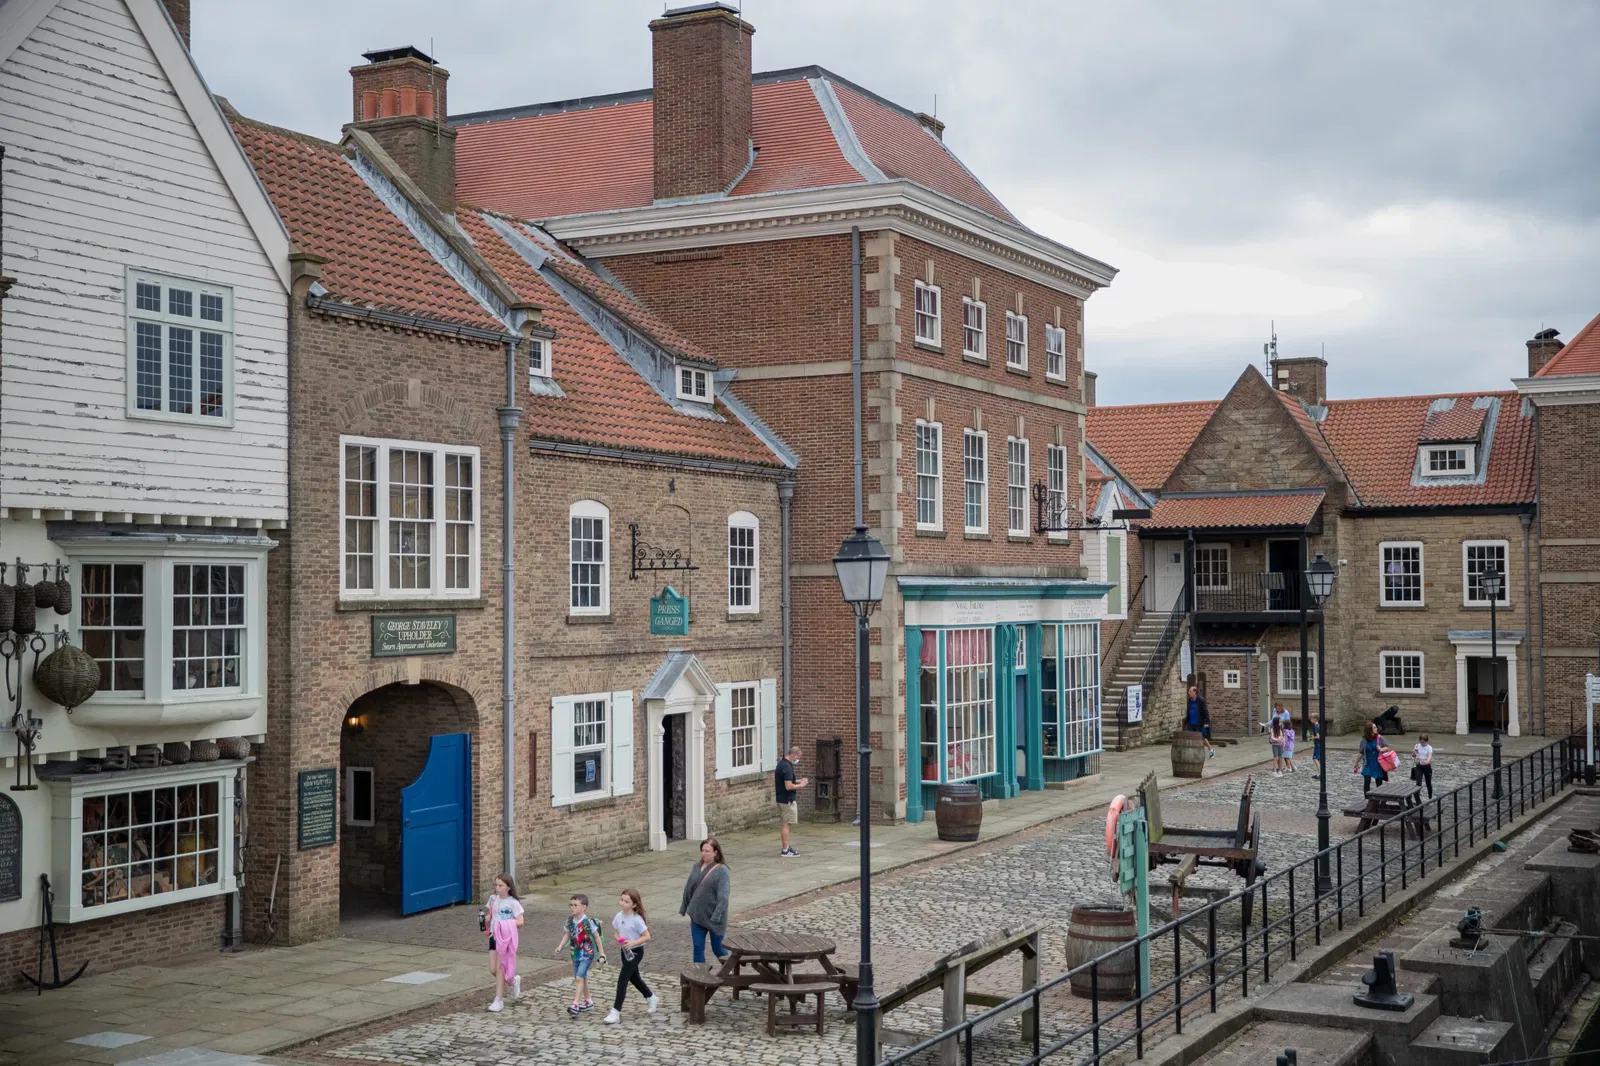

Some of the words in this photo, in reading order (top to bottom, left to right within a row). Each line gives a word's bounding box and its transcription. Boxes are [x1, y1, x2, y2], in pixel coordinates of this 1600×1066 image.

[657, 604, 680, 614] PRESS
[388, 621, 411, 630] GEORGE
[412, 620, 443, 630] STAVELEY
[654, 617, 683, 626] GANGED
[398, 631, 432, 640] UPHOLDER
[382, 642, 396, 650] Sworn
